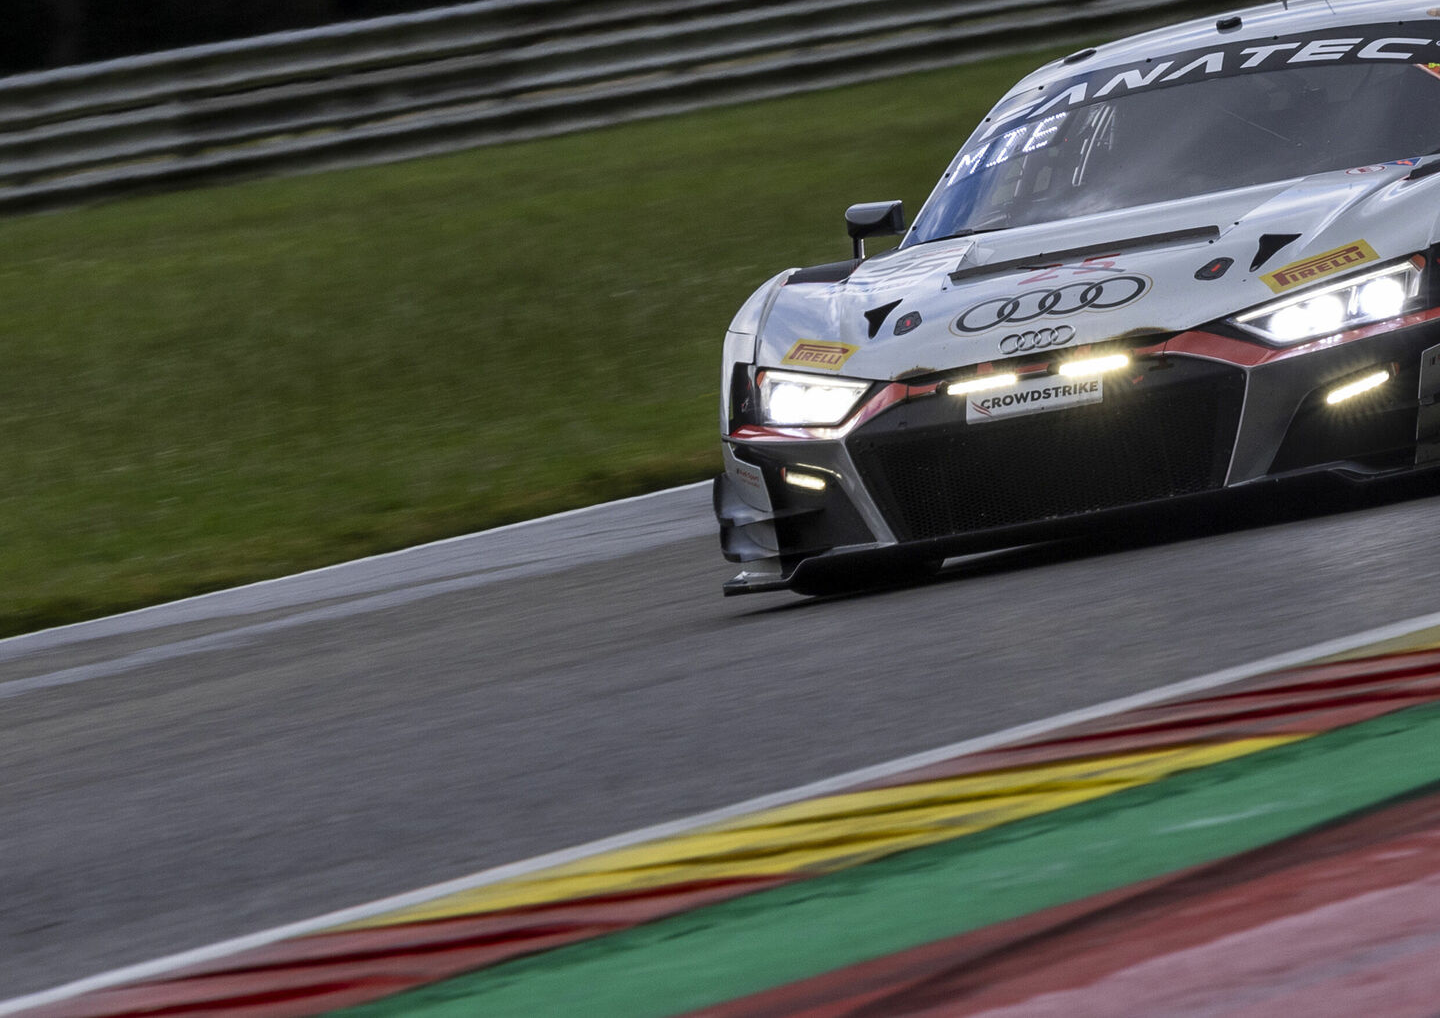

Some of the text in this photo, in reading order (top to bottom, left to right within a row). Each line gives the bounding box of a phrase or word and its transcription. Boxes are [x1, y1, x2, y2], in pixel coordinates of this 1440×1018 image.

[1272, 245, 1366, 287] PIRELLI
[788, 343, 850, 365] PIRELLI
[980, 381, 1099, 411] CROWDSTRIKE
